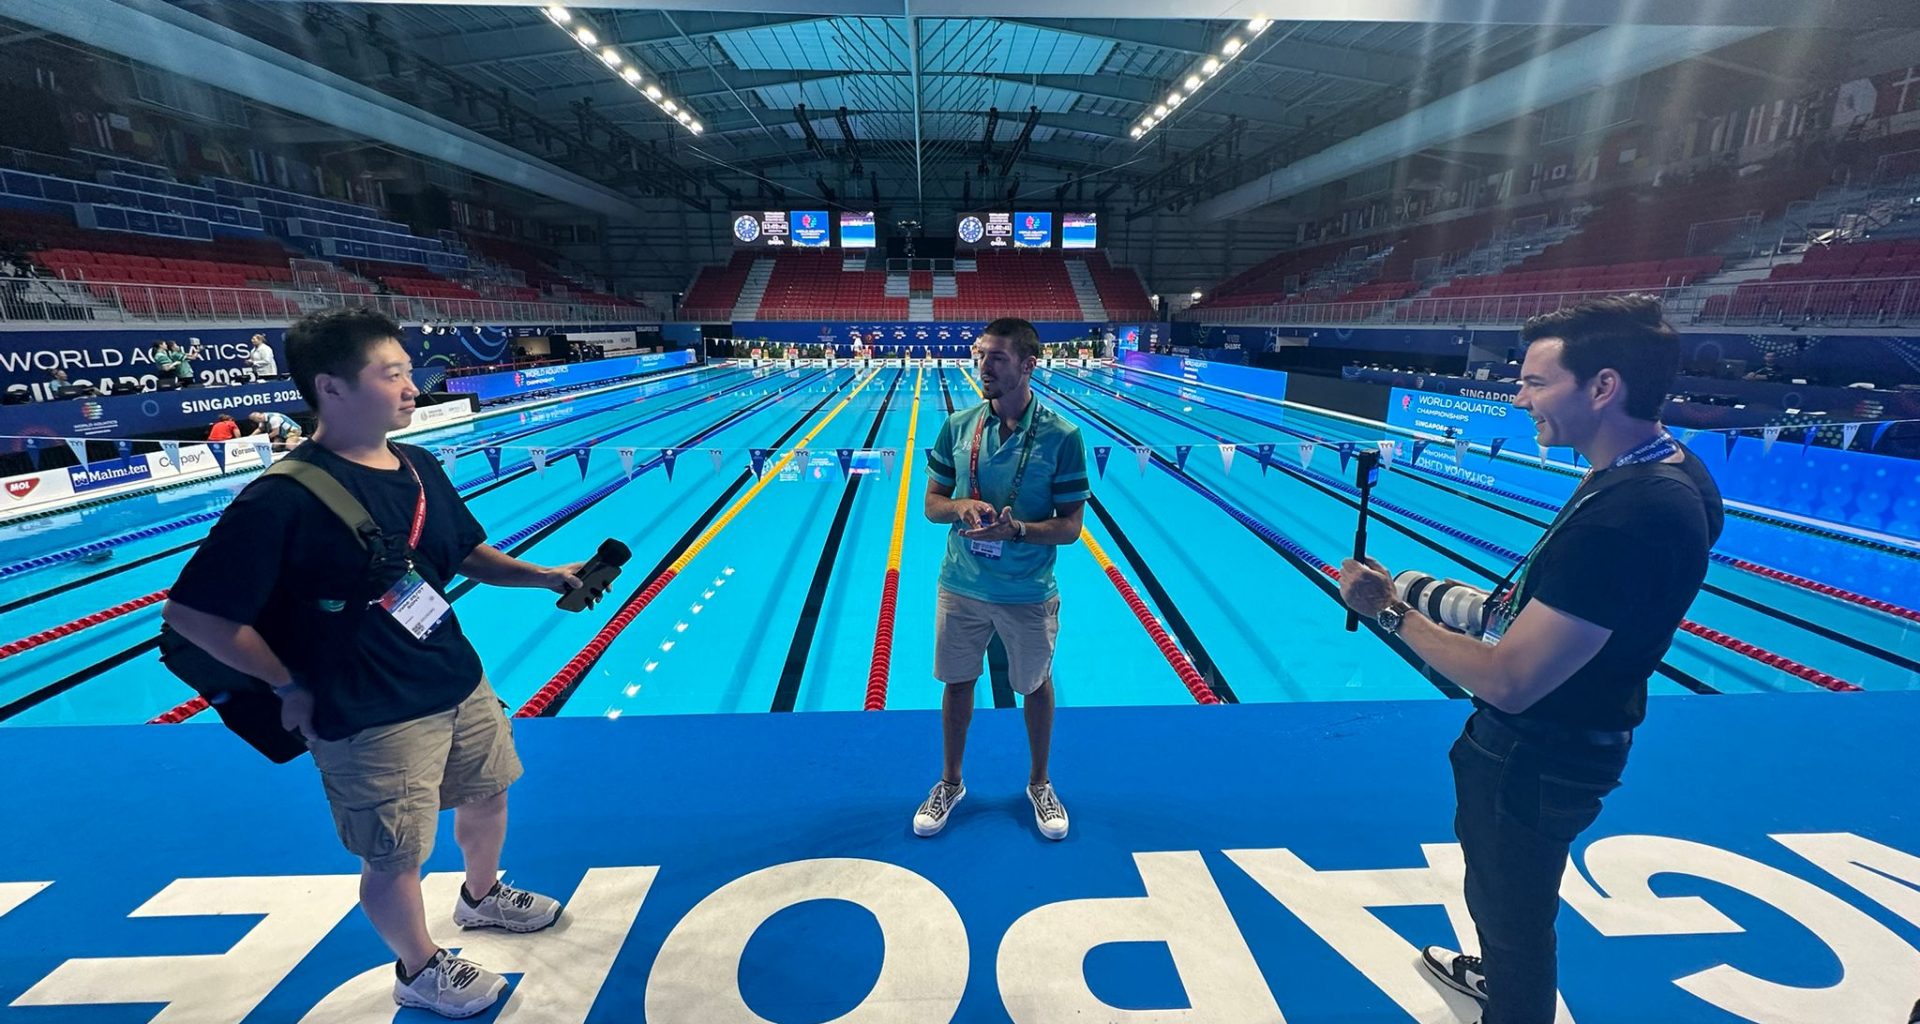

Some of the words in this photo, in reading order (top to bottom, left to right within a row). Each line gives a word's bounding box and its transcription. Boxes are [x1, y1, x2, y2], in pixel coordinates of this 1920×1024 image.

[0, 348, 123, 373] WORLD
[181, 392, 271, 414] SINGAPORE
[1419, 395, 1453, 409] WORLD
[1453, 401, 1507, 417] AQUATICS
[1417, 407, 1469, 422] CHAMPIONSHIPS
[10, 481, 31, 492] MOL
